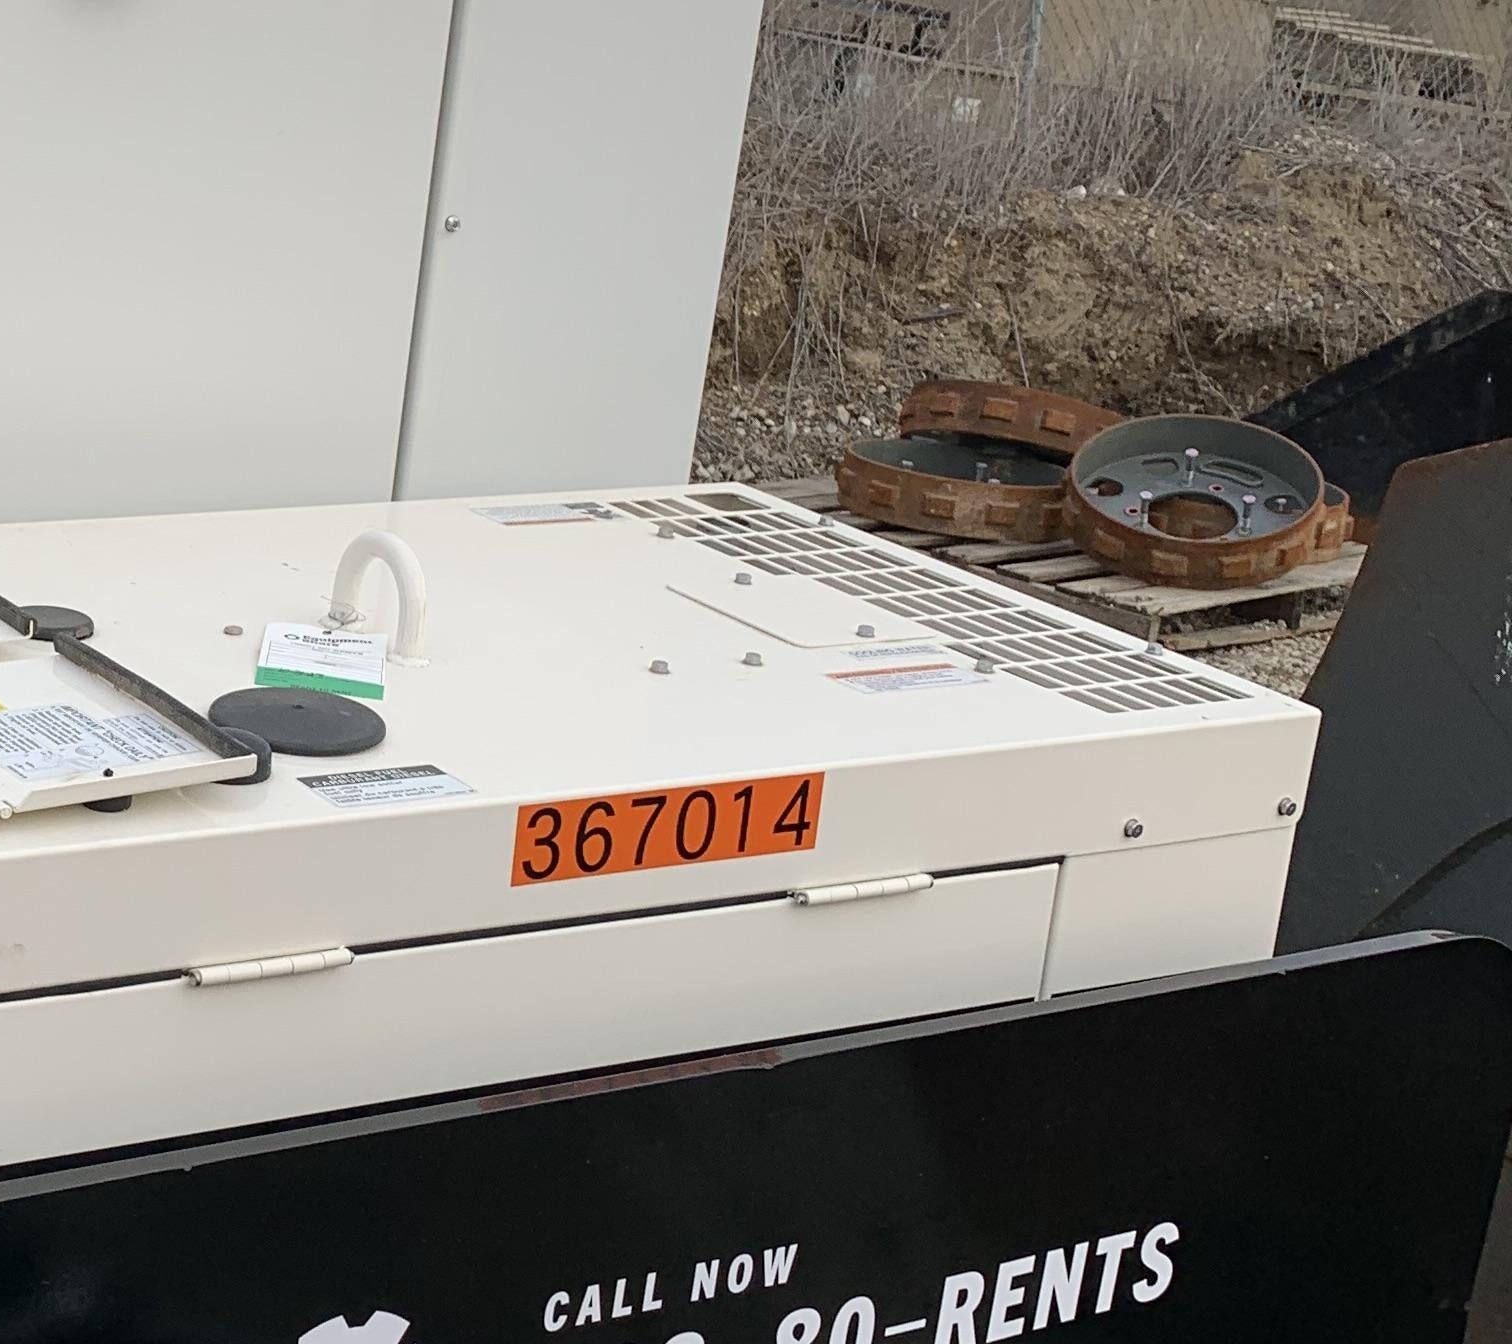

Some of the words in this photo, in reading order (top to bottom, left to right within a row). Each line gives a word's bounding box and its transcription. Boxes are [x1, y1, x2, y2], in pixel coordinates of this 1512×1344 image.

[327, 771, 374, 781] DIESEL
[377, 768, 403, 776] FUEL
[522, 779, 811, 880] 367014
[542, 1271, 666, 1333] CALL
[691, 1242, 799, 1303] NOW
